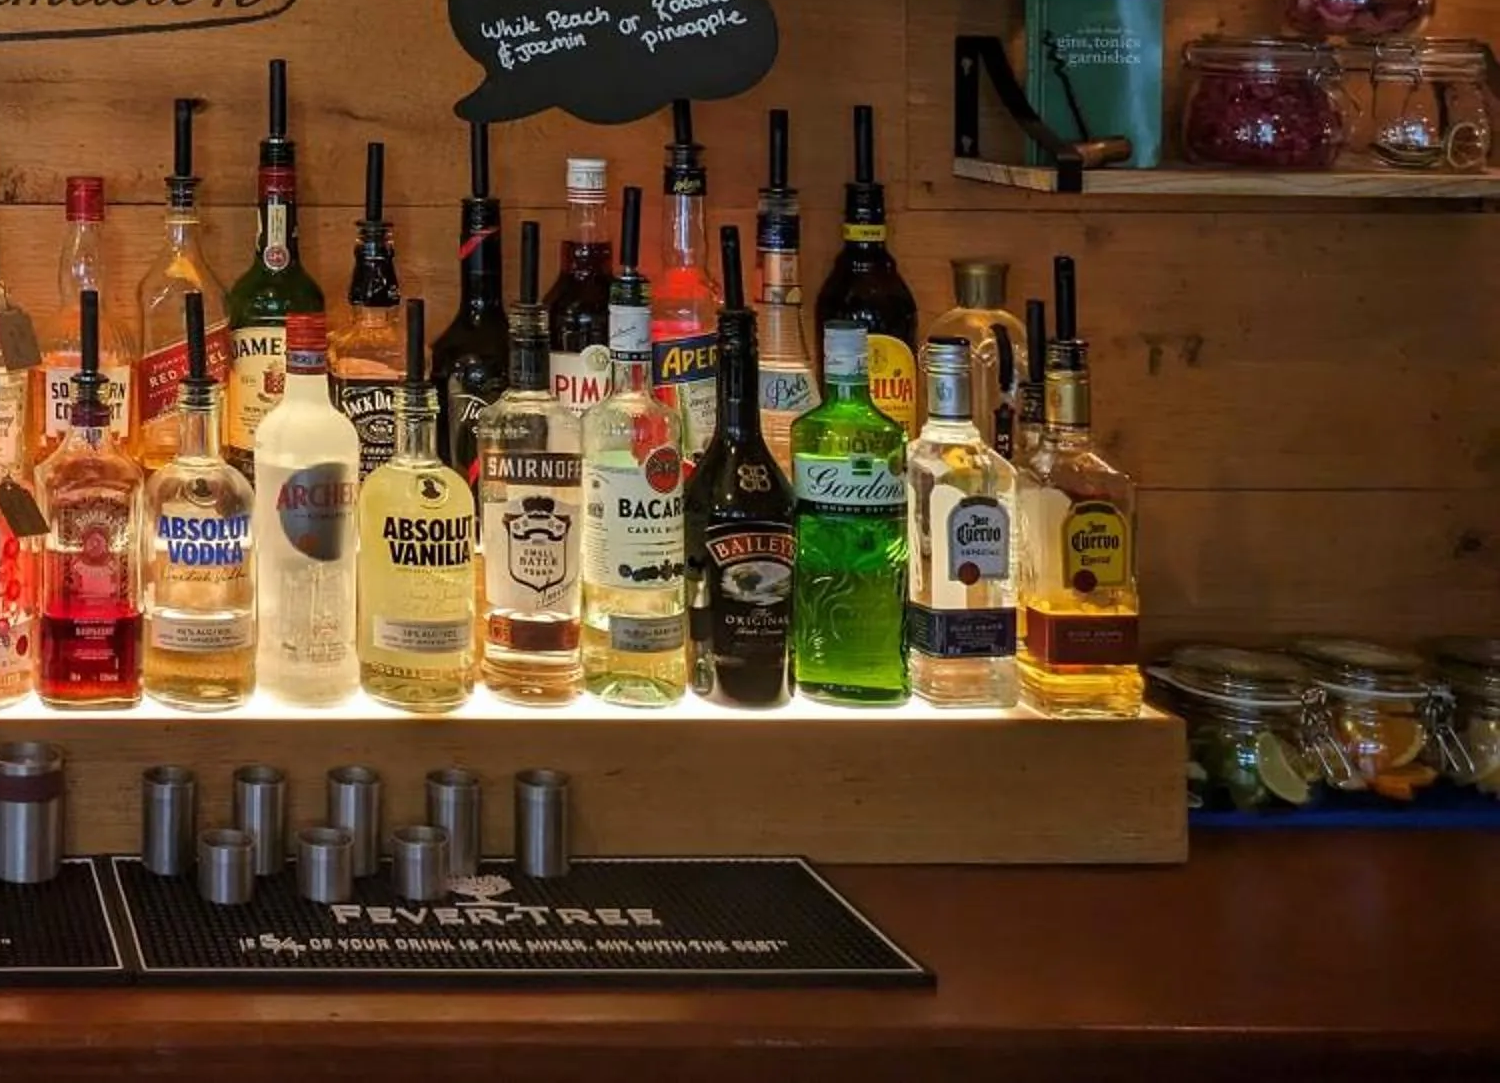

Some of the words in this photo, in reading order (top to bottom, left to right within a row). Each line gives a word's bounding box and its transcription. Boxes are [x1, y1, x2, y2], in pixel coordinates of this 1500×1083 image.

[481, 17, 542, 40] White
[549, 6, 611, 32] Peach
[618, 15, 641, 36] or
[640, 8, 748, 54] pineapple
[231, 337, 287, 359] JAME
[149, 369, 178, 387] RED
[487, 454, 582, 479] SMIRNOFF
[618, 497, 684, 520] BACAR
[158, 515, 250, 541] ABSOLUT
[383, 515, 474, 543] ABSOLUT
[956, 523, 1002, 546] Cuervo
[168, 541, 244, 566] VODKA
[388, 541, 472, 566] VANILIA
[1071, 534, 1120, 552] Cuervo
[330, 904, 662, 926] FEVER-TREE
[337, 937, 390, 953] YOUR
[394, 937, 455, 953] DRINK
